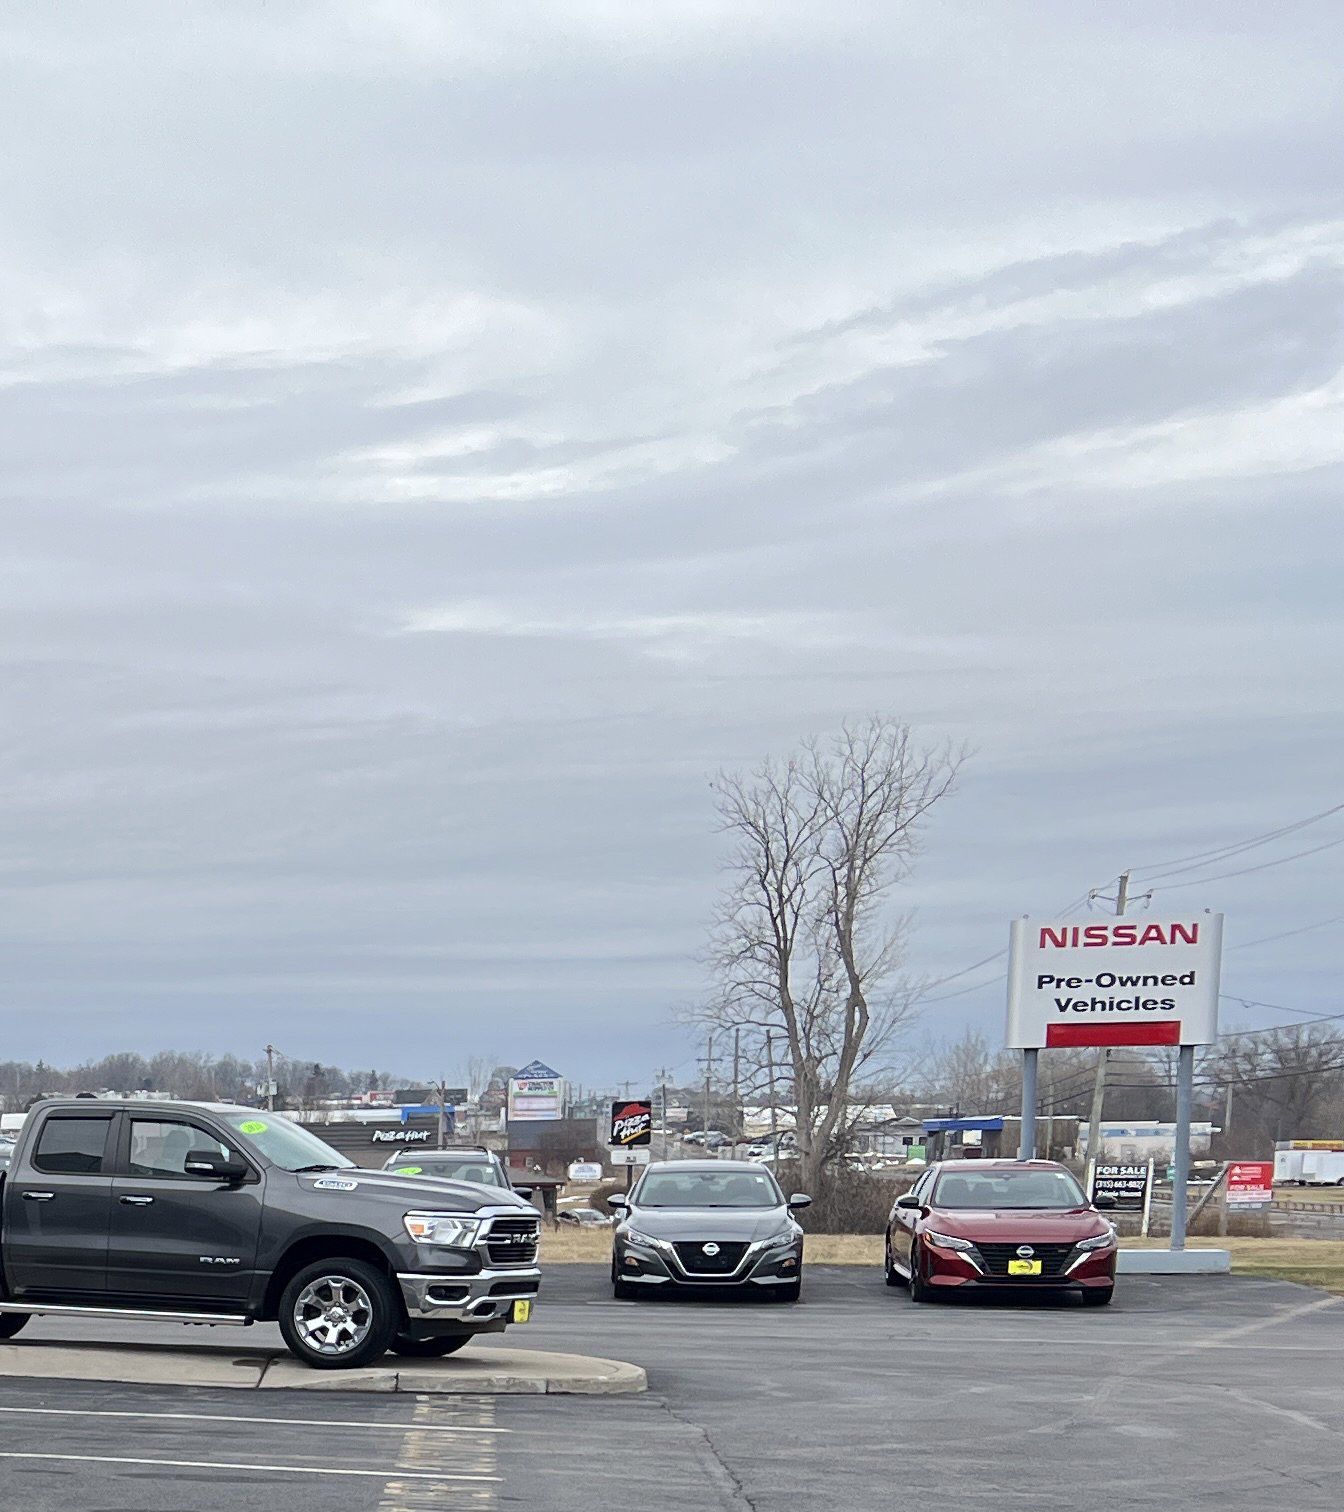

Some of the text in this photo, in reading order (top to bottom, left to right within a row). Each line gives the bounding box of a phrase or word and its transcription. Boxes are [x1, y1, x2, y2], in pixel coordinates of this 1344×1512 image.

[1038, 922, 1200, 949] NISSAN
[1037, 970, 1196, 990] Pre-Owned
[1054, 995, 1176, 1014] Vehicles
[613, 1113, 650, 1137] Pizza
[620, 1122, 647, 1140] Hut
[372, 1130, 431, 1143] Pizza Hut
[1096, 1166, 1147, 1175] FOR SALE
[199, 1256, 240, 1265] RAM
